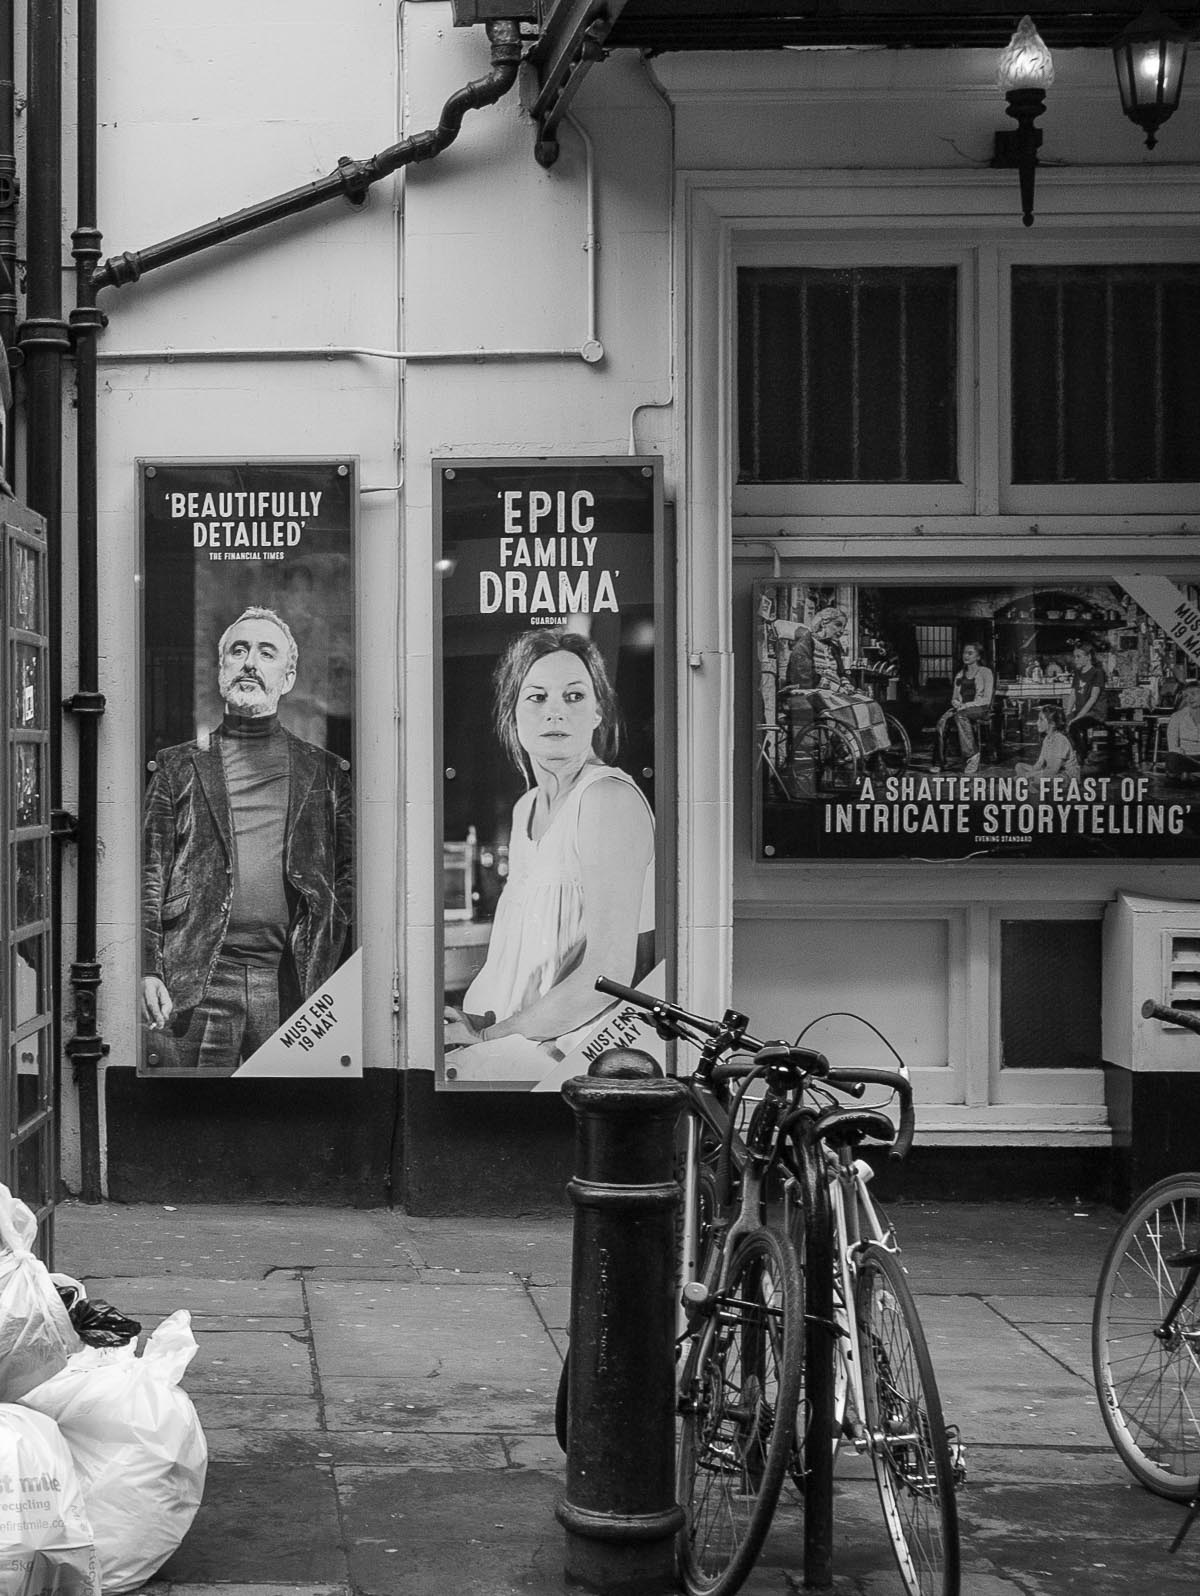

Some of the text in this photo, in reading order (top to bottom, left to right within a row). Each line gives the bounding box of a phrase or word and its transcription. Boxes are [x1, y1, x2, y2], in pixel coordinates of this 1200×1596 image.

[209, 551, 285, 560] THE FINANCIAL TIMES
[499, 536, 598, 567] FAMILY
[530, 616, 568, 625] GUARDIAN
[1174, 602, 1200, 637] MUS
[1170, 621, 1200, 659] 19 MA
[885, 776, 1029, 802] SHATTERING
[1038, 777, 1109, 802] FEAST
[1121, 777, 1149, 802] OF
[824, 803, 971, 833] INTRICATE
[279, 993, 334, 1049] MUST END
[297, 1010, 338, 1052] 19 MAY
[612, 1023, 642, 1049] MAY
[581, 1026, 615, 1062] MUST
[19, 1472, 63, 1493] mile
